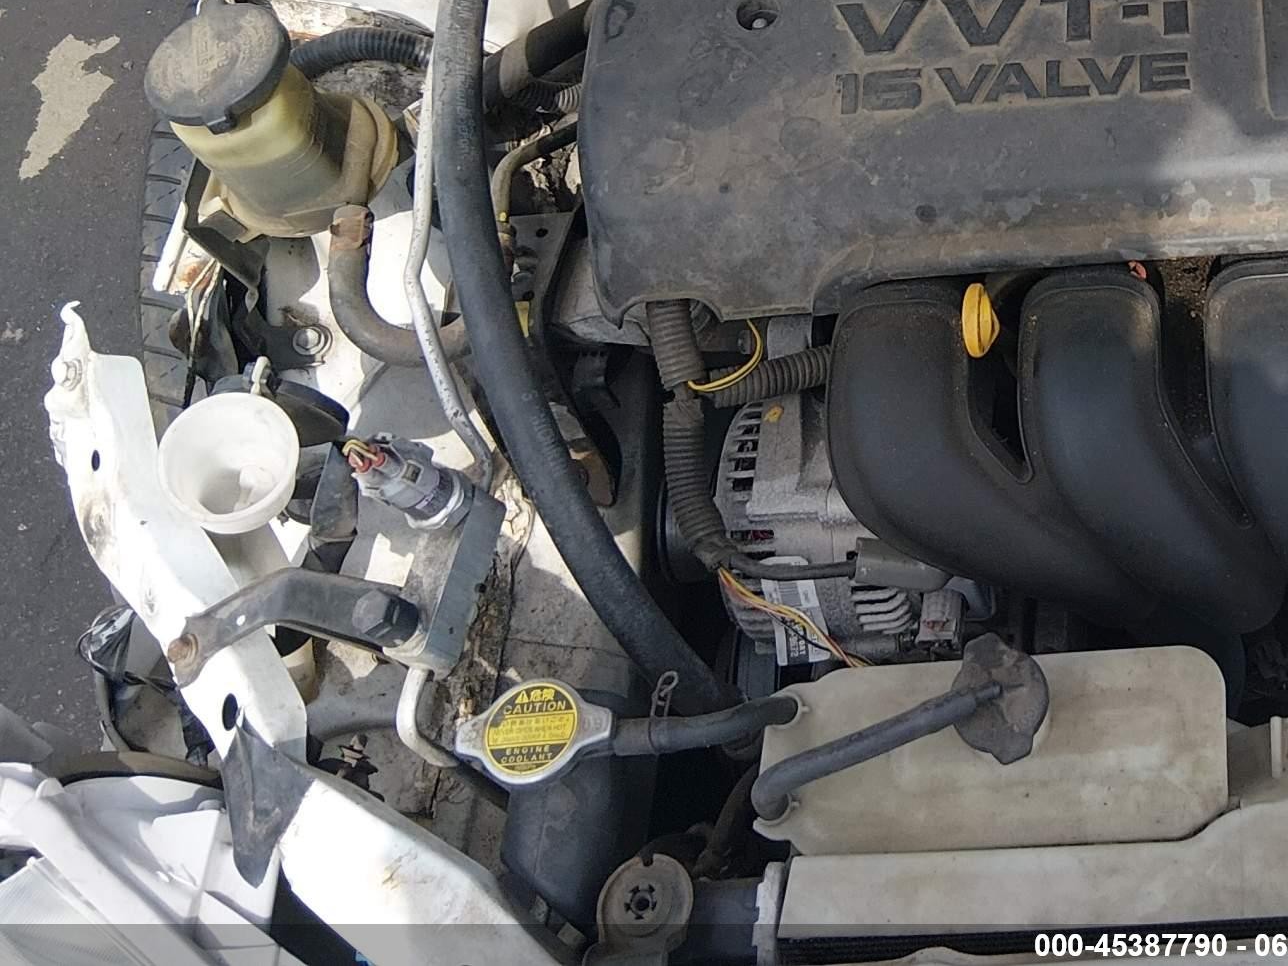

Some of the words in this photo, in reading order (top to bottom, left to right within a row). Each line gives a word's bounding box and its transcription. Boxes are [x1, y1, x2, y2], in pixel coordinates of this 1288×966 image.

[503, 700, 567, 715] CAUTION
[505, 745, 551, 755] ENGINE
[501, 752, 553, 764] COOLANT
